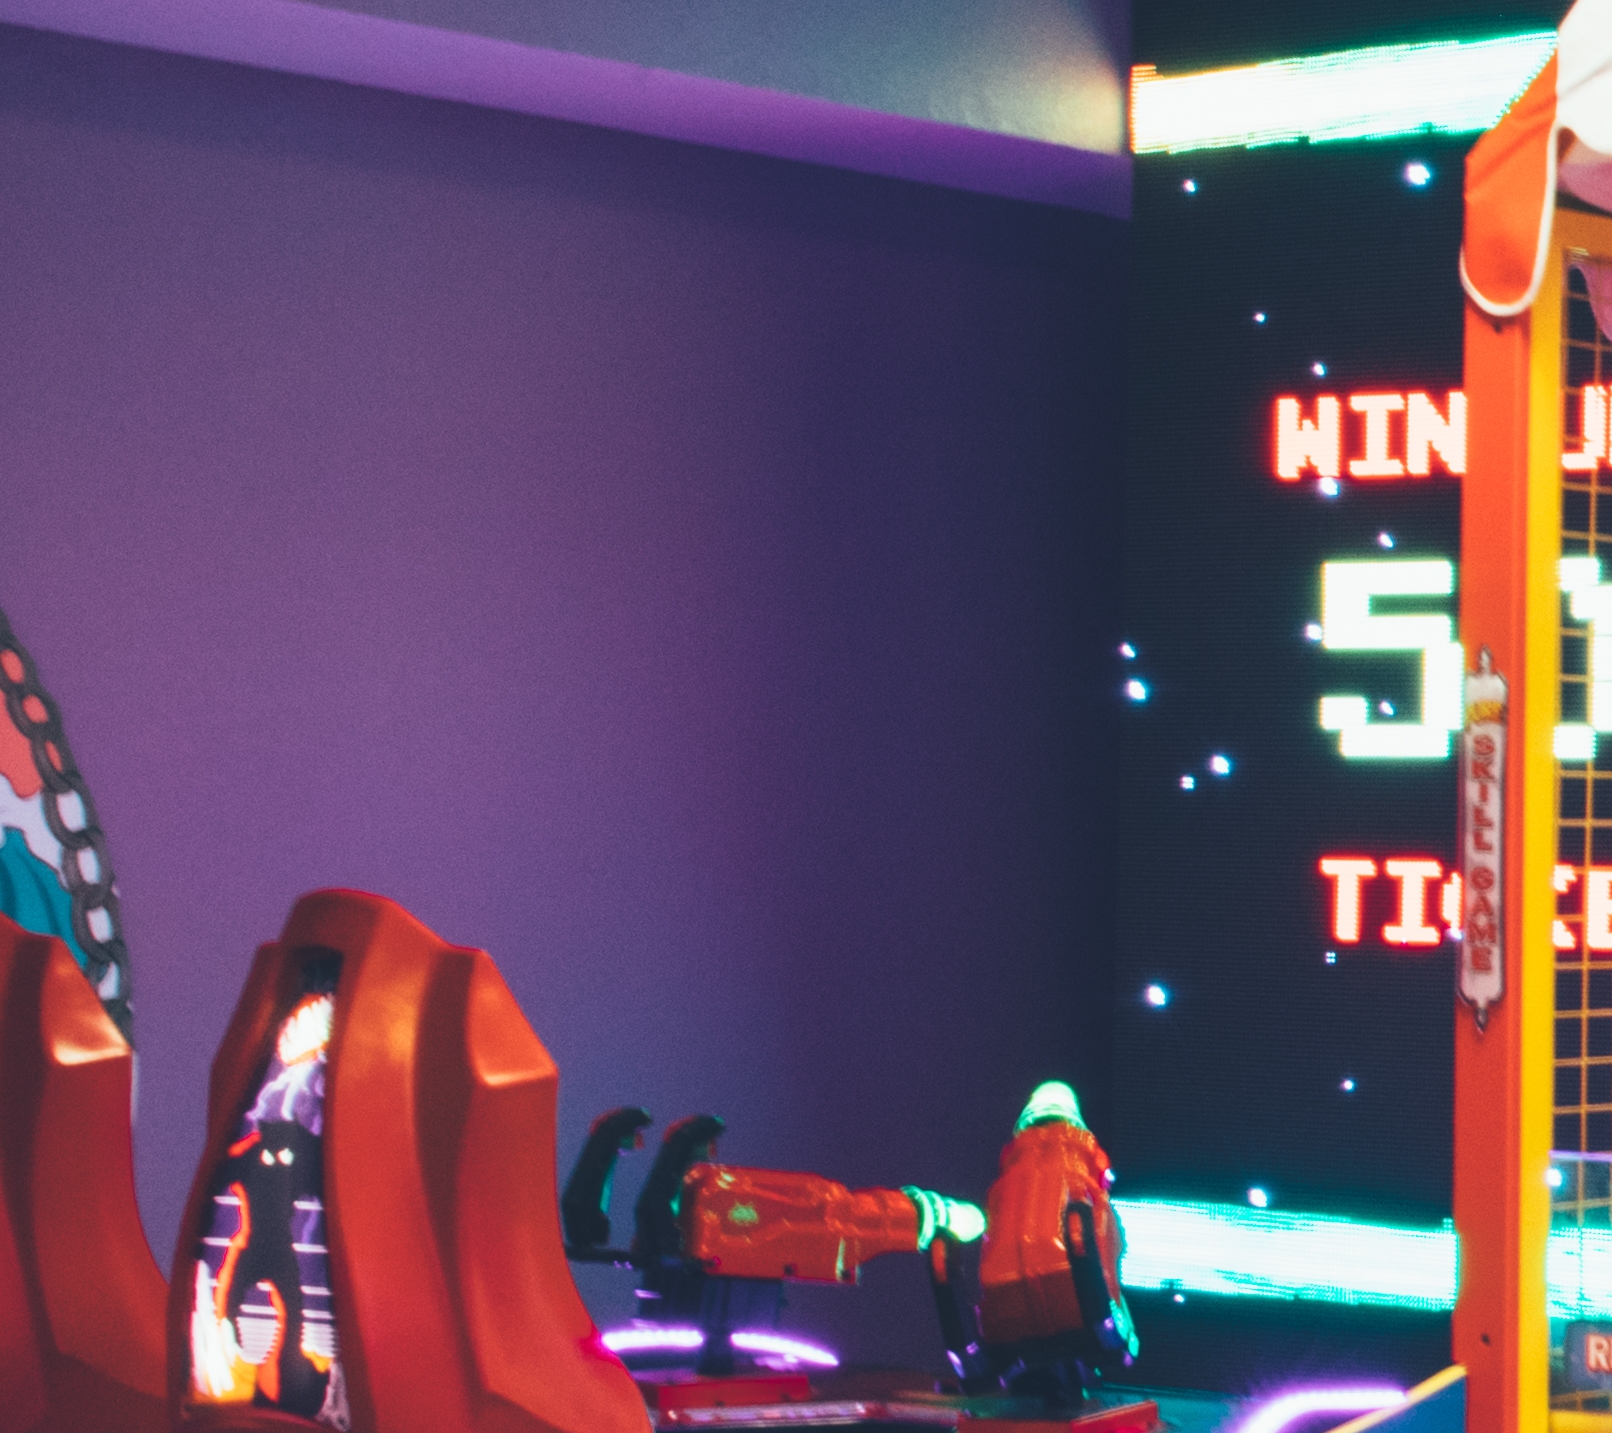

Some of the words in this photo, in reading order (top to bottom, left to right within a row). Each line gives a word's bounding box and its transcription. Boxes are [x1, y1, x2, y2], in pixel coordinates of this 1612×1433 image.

[1274, 389, 1468, 481] WIN
[1470, 733, 1496, 854] SKILL
[1467, 865, 1497, 974] GAME
